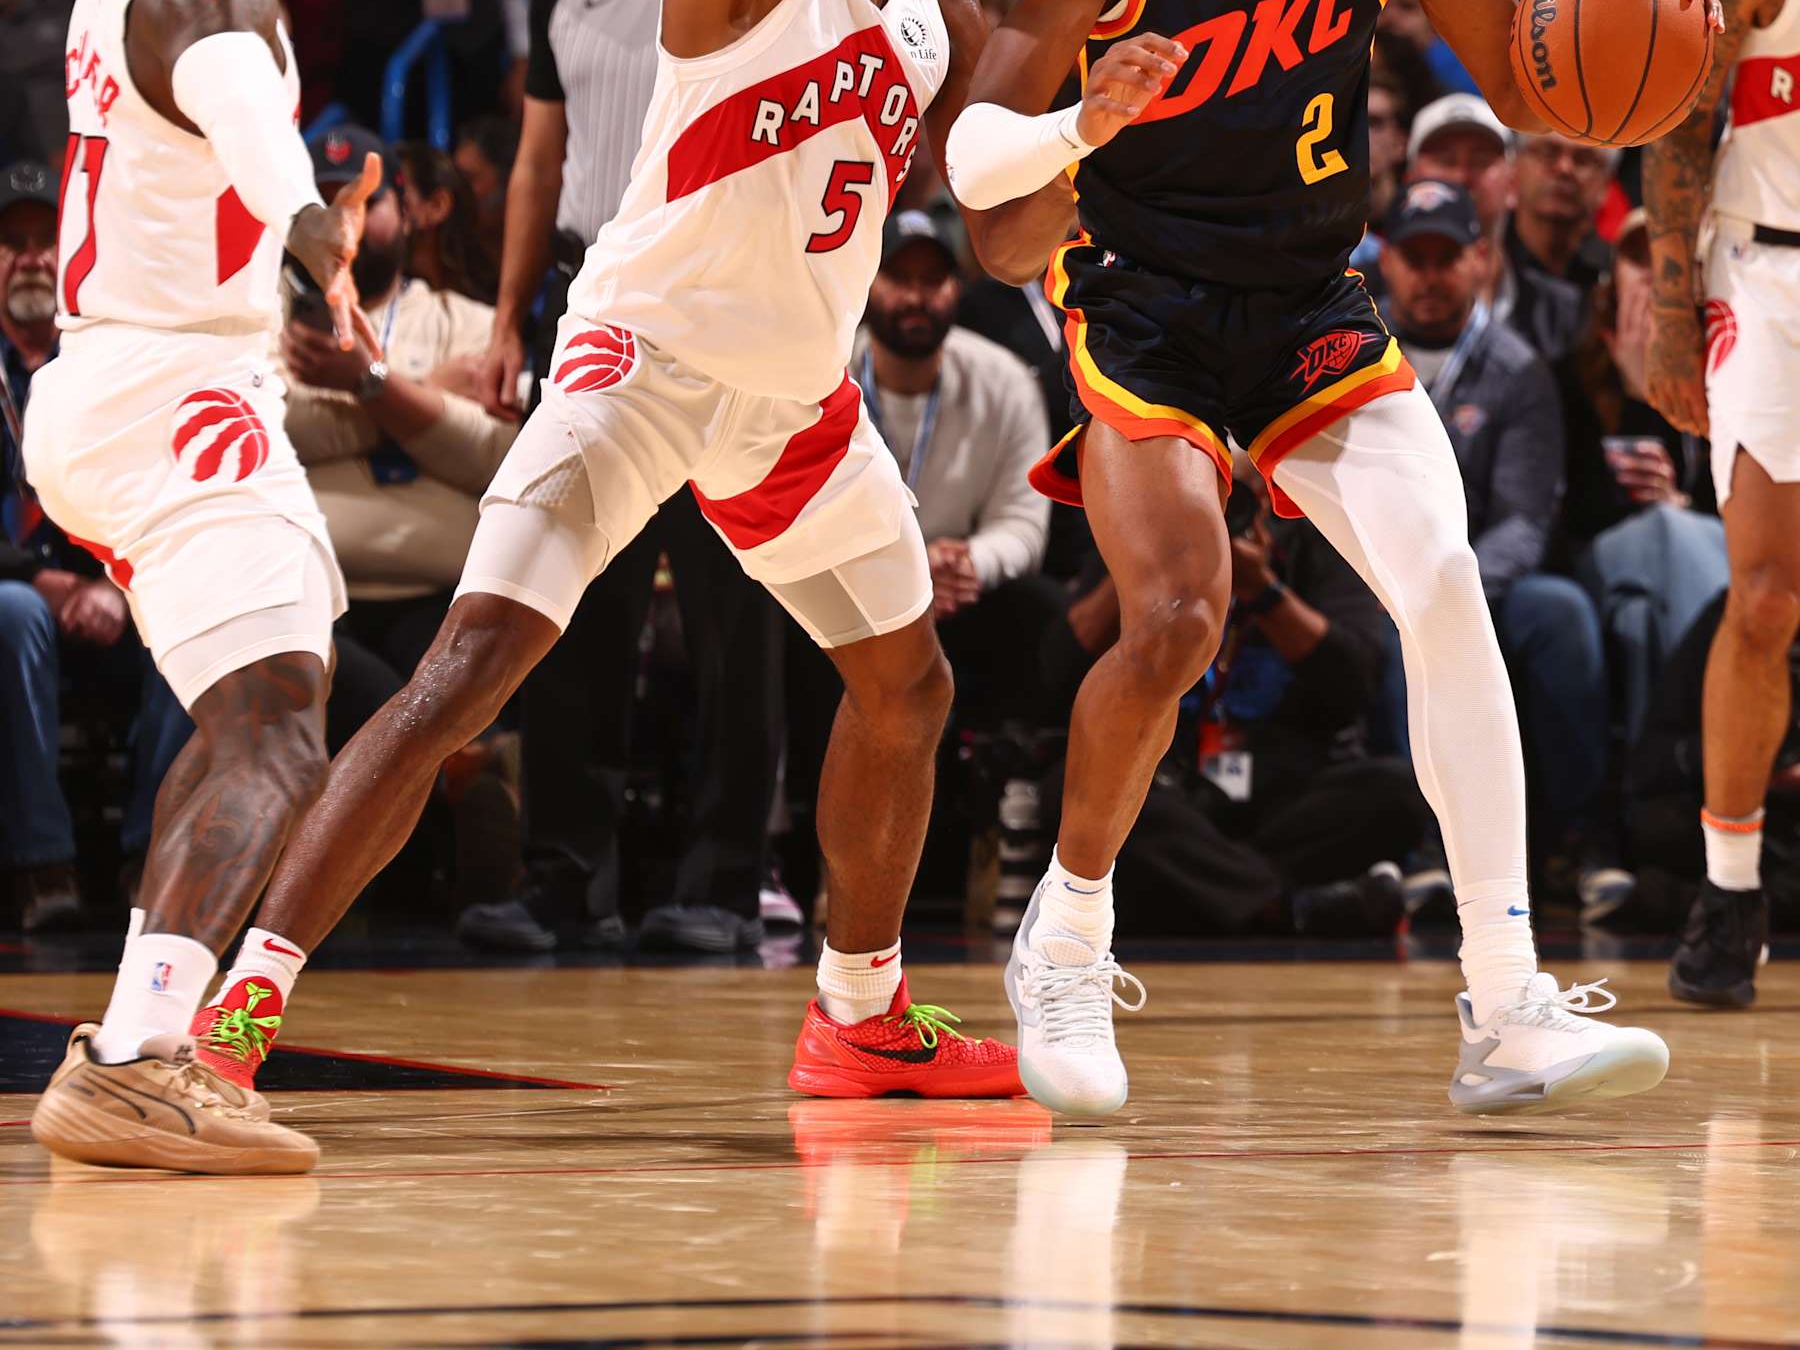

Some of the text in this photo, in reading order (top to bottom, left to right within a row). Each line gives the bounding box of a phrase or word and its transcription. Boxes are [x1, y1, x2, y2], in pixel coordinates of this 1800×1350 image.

[918, 48, 937, 60] Life
[1296, 92, 1349, 186] 2
[805, 160, 874, 253] 5
